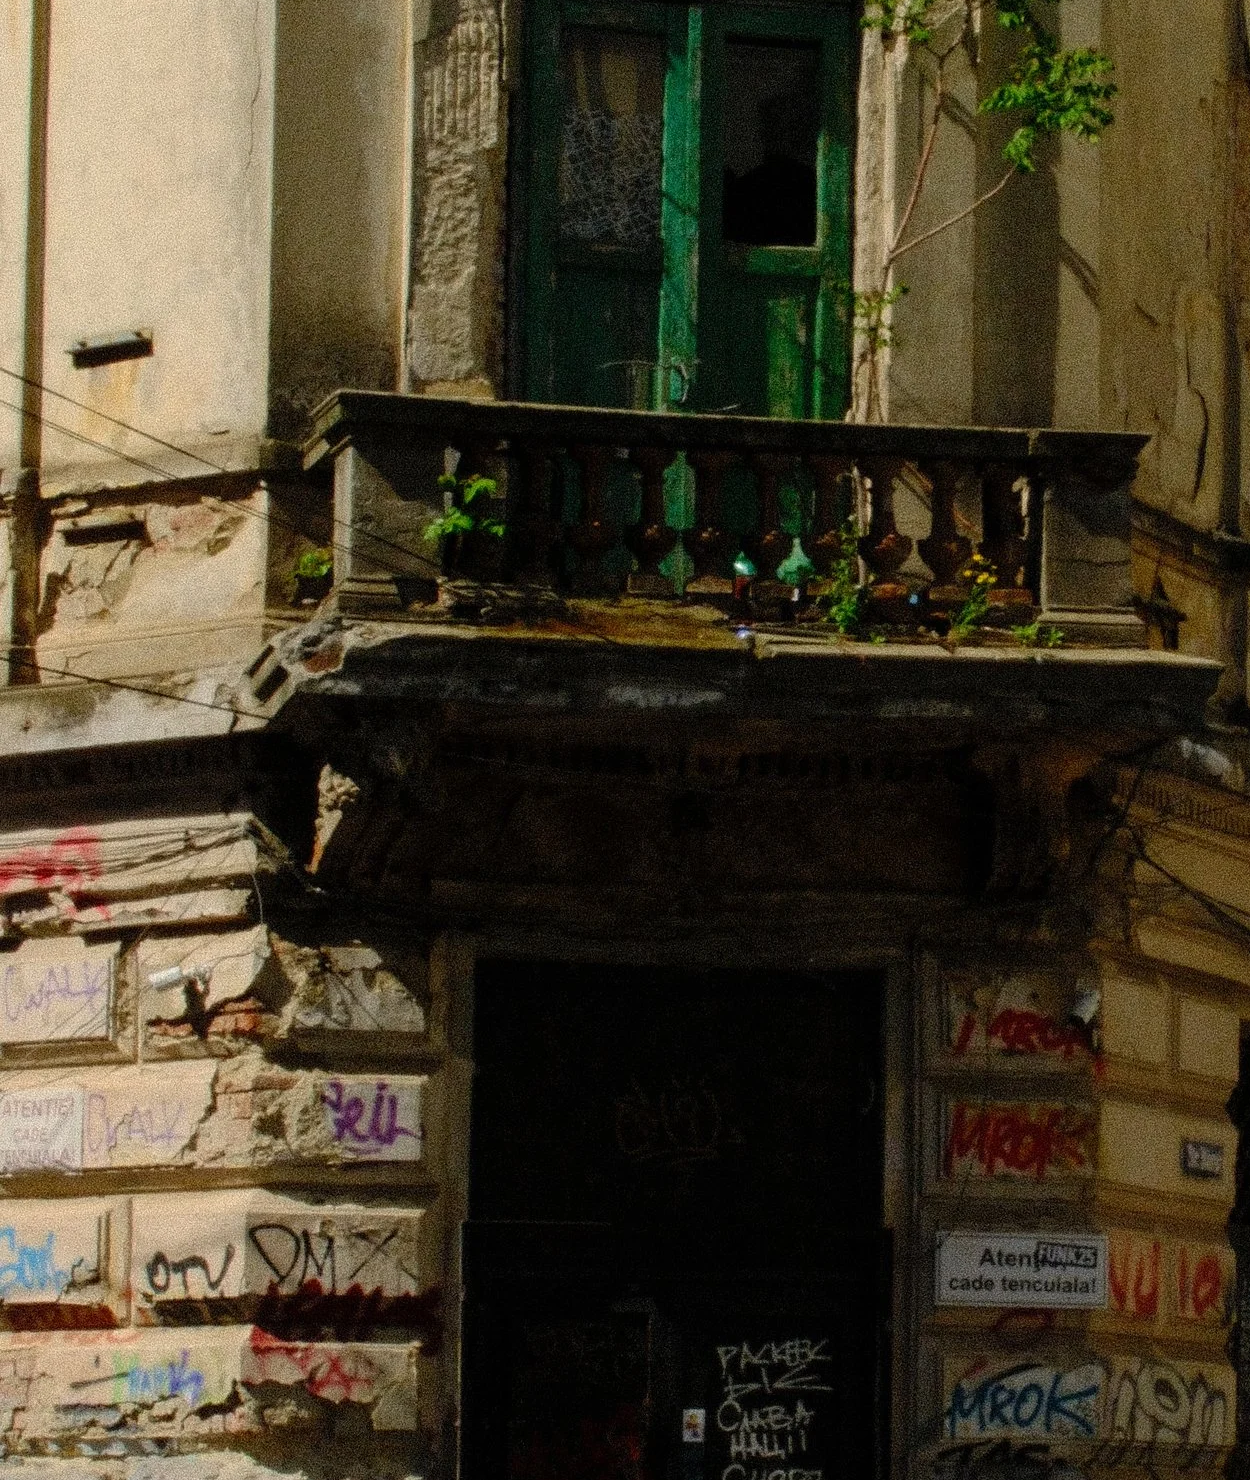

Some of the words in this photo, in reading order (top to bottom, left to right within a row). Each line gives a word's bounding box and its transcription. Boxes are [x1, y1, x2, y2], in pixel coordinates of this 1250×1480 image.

[949, 1274, 995, 1292] cade
[1001, 1276, 1096, 1294] tencuiala!
[946, 1373, 1099, 1438] MROK
